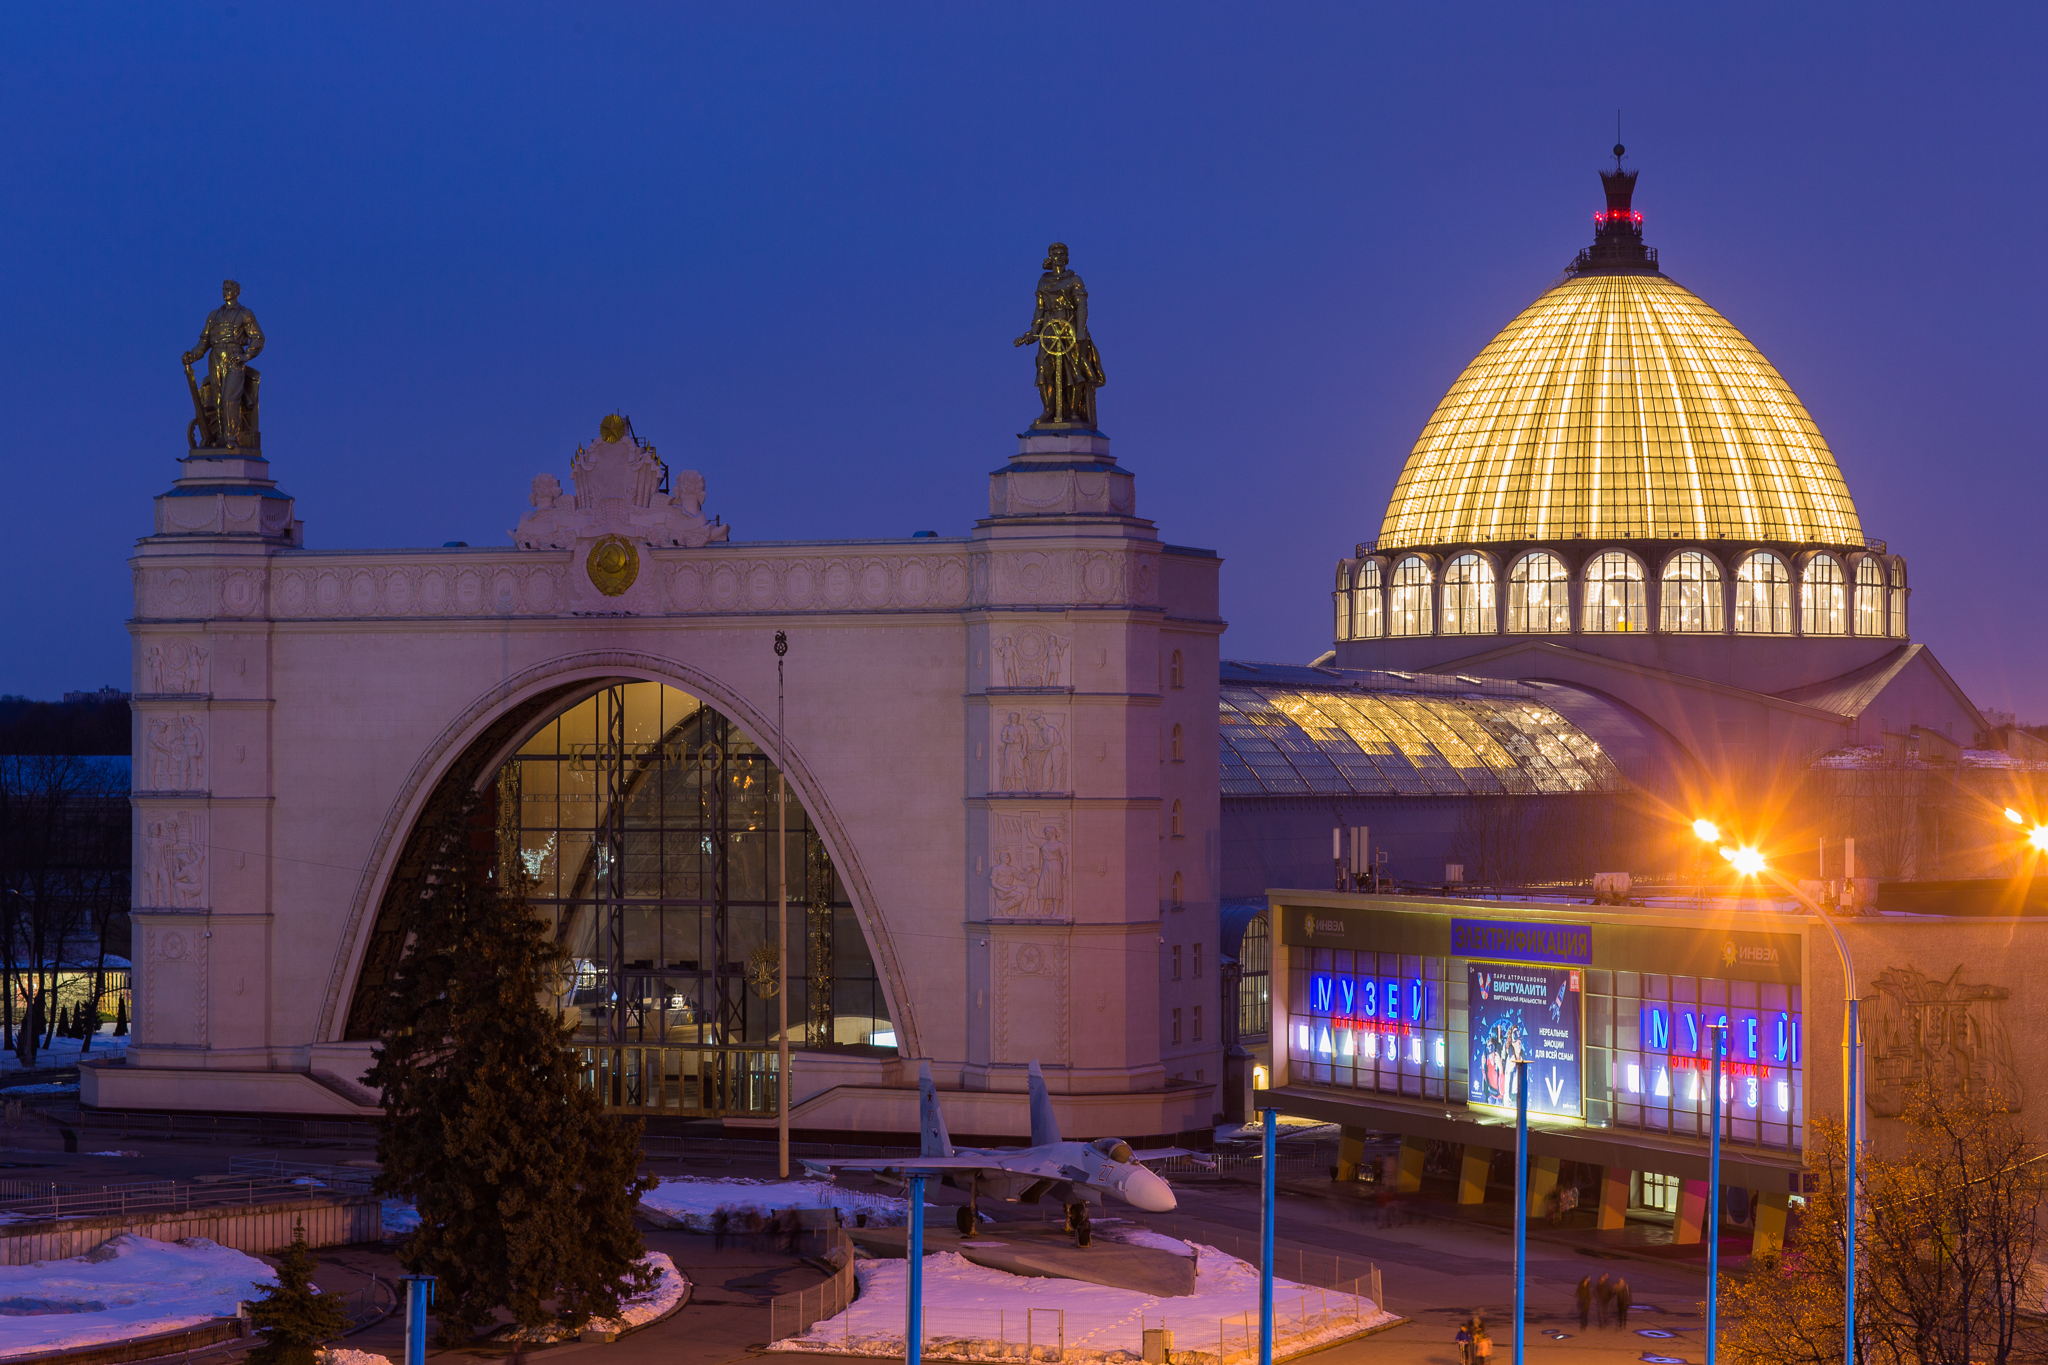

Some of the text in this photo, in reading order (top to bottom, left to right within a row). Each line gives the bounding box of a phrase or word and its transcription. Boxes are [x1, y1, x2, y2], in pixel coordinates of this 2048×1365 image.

[567, 743, 754, 771] КОСМОС
[1455, 926, 1587, 959] ЭЛЕКТРИФИКАЦИЯ
[1739, 946, 1779, 961] ИНВЭЛ
[1508, 974, 1547, 984] АТТРАКЦИОНОВ
[1493, 980, 1547, 997] ВИРТУАЛИТИ
[1318, 977, 1429, 1021] МУЗЕЙ
[1493, 994, 1519, 1002] ВИРТУАЛЬНОЙ
[1538, 1027, 1569, 1039] НЕРЕАЛЬНЫЕ
[1543, 1039, 1565, 1049] ЭМОЦИИ
[1535, 1049, 1574, 1062] ДЛЯ ВСЕЙ СЕМЬИ
[1672, 1055, 1769, 1079] ОПТИЕСКИХ
[1098, 1164, 1115, 1182] 27
